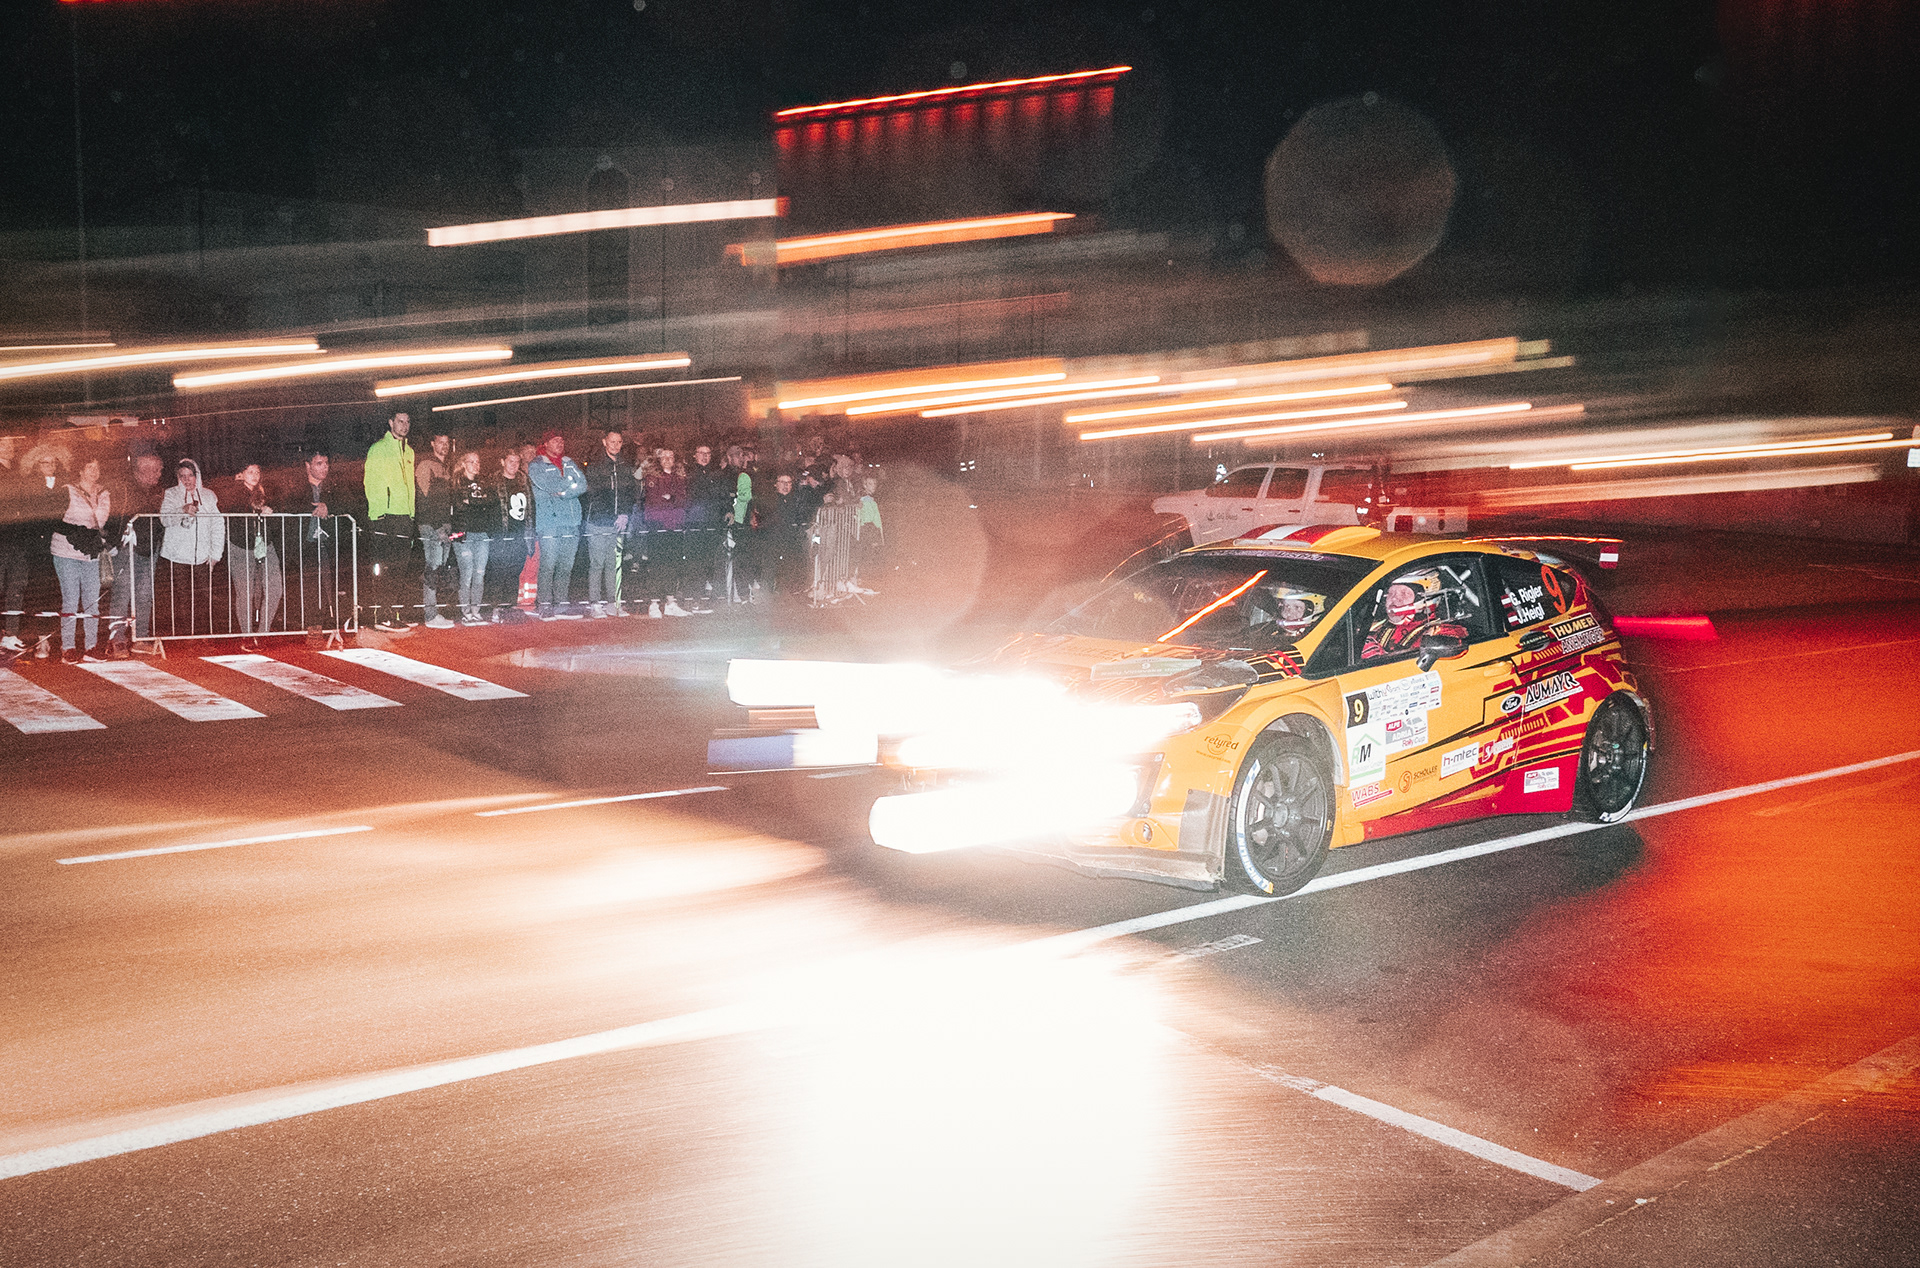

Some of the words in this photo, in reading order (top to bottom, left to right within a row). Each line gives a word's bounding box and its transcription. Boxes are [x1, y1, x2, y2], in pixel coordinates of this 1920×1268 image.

[1509, 592, 1521, 606] G.
[1518, 585, 1543, 603] Rigler
[1541, 565, 1566, 614] 9
[1555, 616, 1596, 637] HUMER
[1525, 671, 1580, 704] AUMAYR
[1354, 699, 1364, 722] 9
[1204, 735, 1240, 750] retyred
[1351, 743, 1371, 766] RM
[1443, 747, 1478, 767] h-mtec
[1352, 782, 1380, 802] WABS
